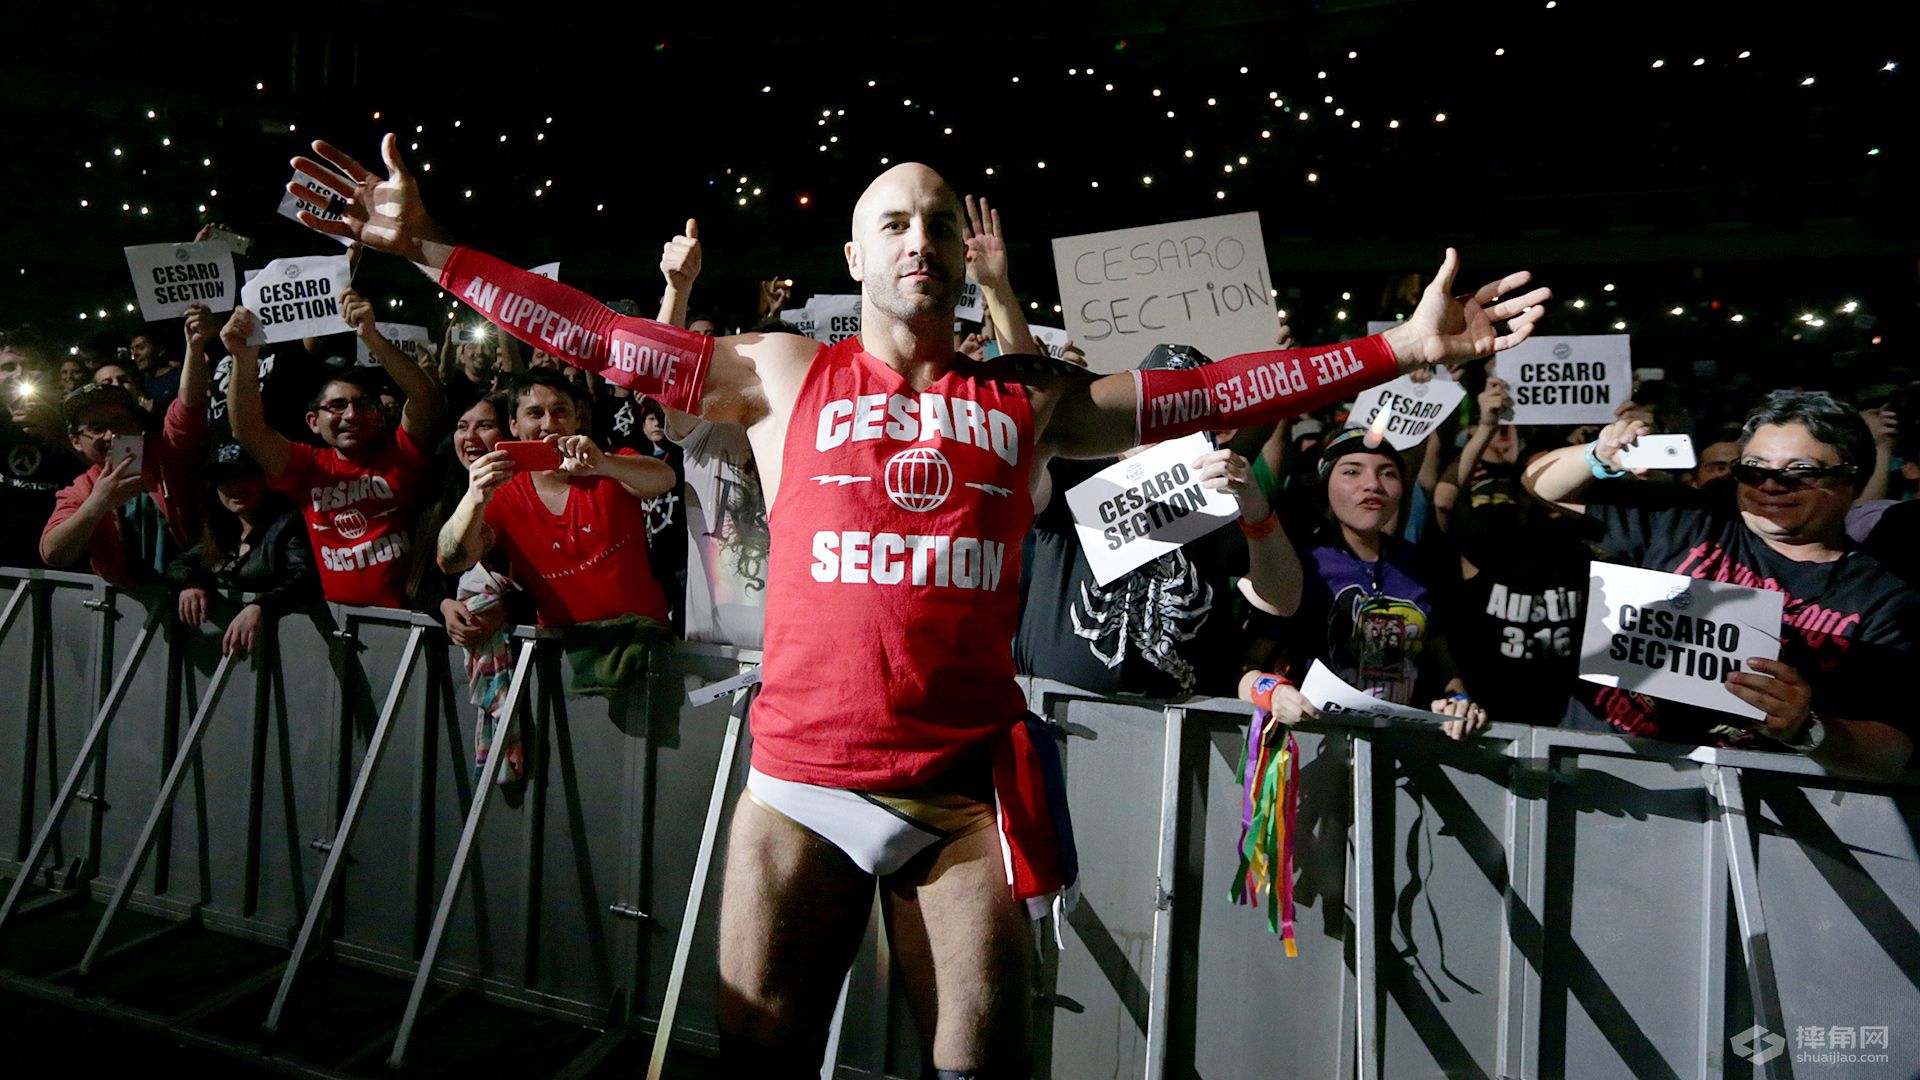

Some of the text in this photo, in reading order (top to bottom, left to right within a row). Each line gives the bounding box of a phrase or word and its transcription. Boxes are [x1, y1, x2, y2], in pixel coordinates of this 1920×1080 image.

[152, 262, 220, 285] CESARO
[1074, 235, 1246, 286] CESARO
[154, 281, 225, 305] SECTION
[259, 277, 331, 304] CESARO
[259, 297, 338, 326] SECTION
[831, 316, 862, 332] CES
[463, 275, 501, 313] AN
[607, 339, 681, 385] ABOVE
[1047, 343, 1064, 359] RO
[1310, 346, 1365, 386] THE
[1520, 362, 1606, 383] CESARO
[1378, 390, 1443, 419] CESARO
[1517, 385, 1610, 405] SECTION
[815, 392, 1018, 467] CESARO
[1366, 408, 1435, 436] SCTION
[310, 474, 394, 513] CESARO
[1098, 463, 1190, 524] CESARO
[1103, 484, 1208, 551] SECTION
[810, 530, 1005, 592] SECTION
[1500, 626, 1572, 660] 3:16
[1618, 604, 1741, 653] CESARO
[1609, 634, 1742, 684] SECTION
